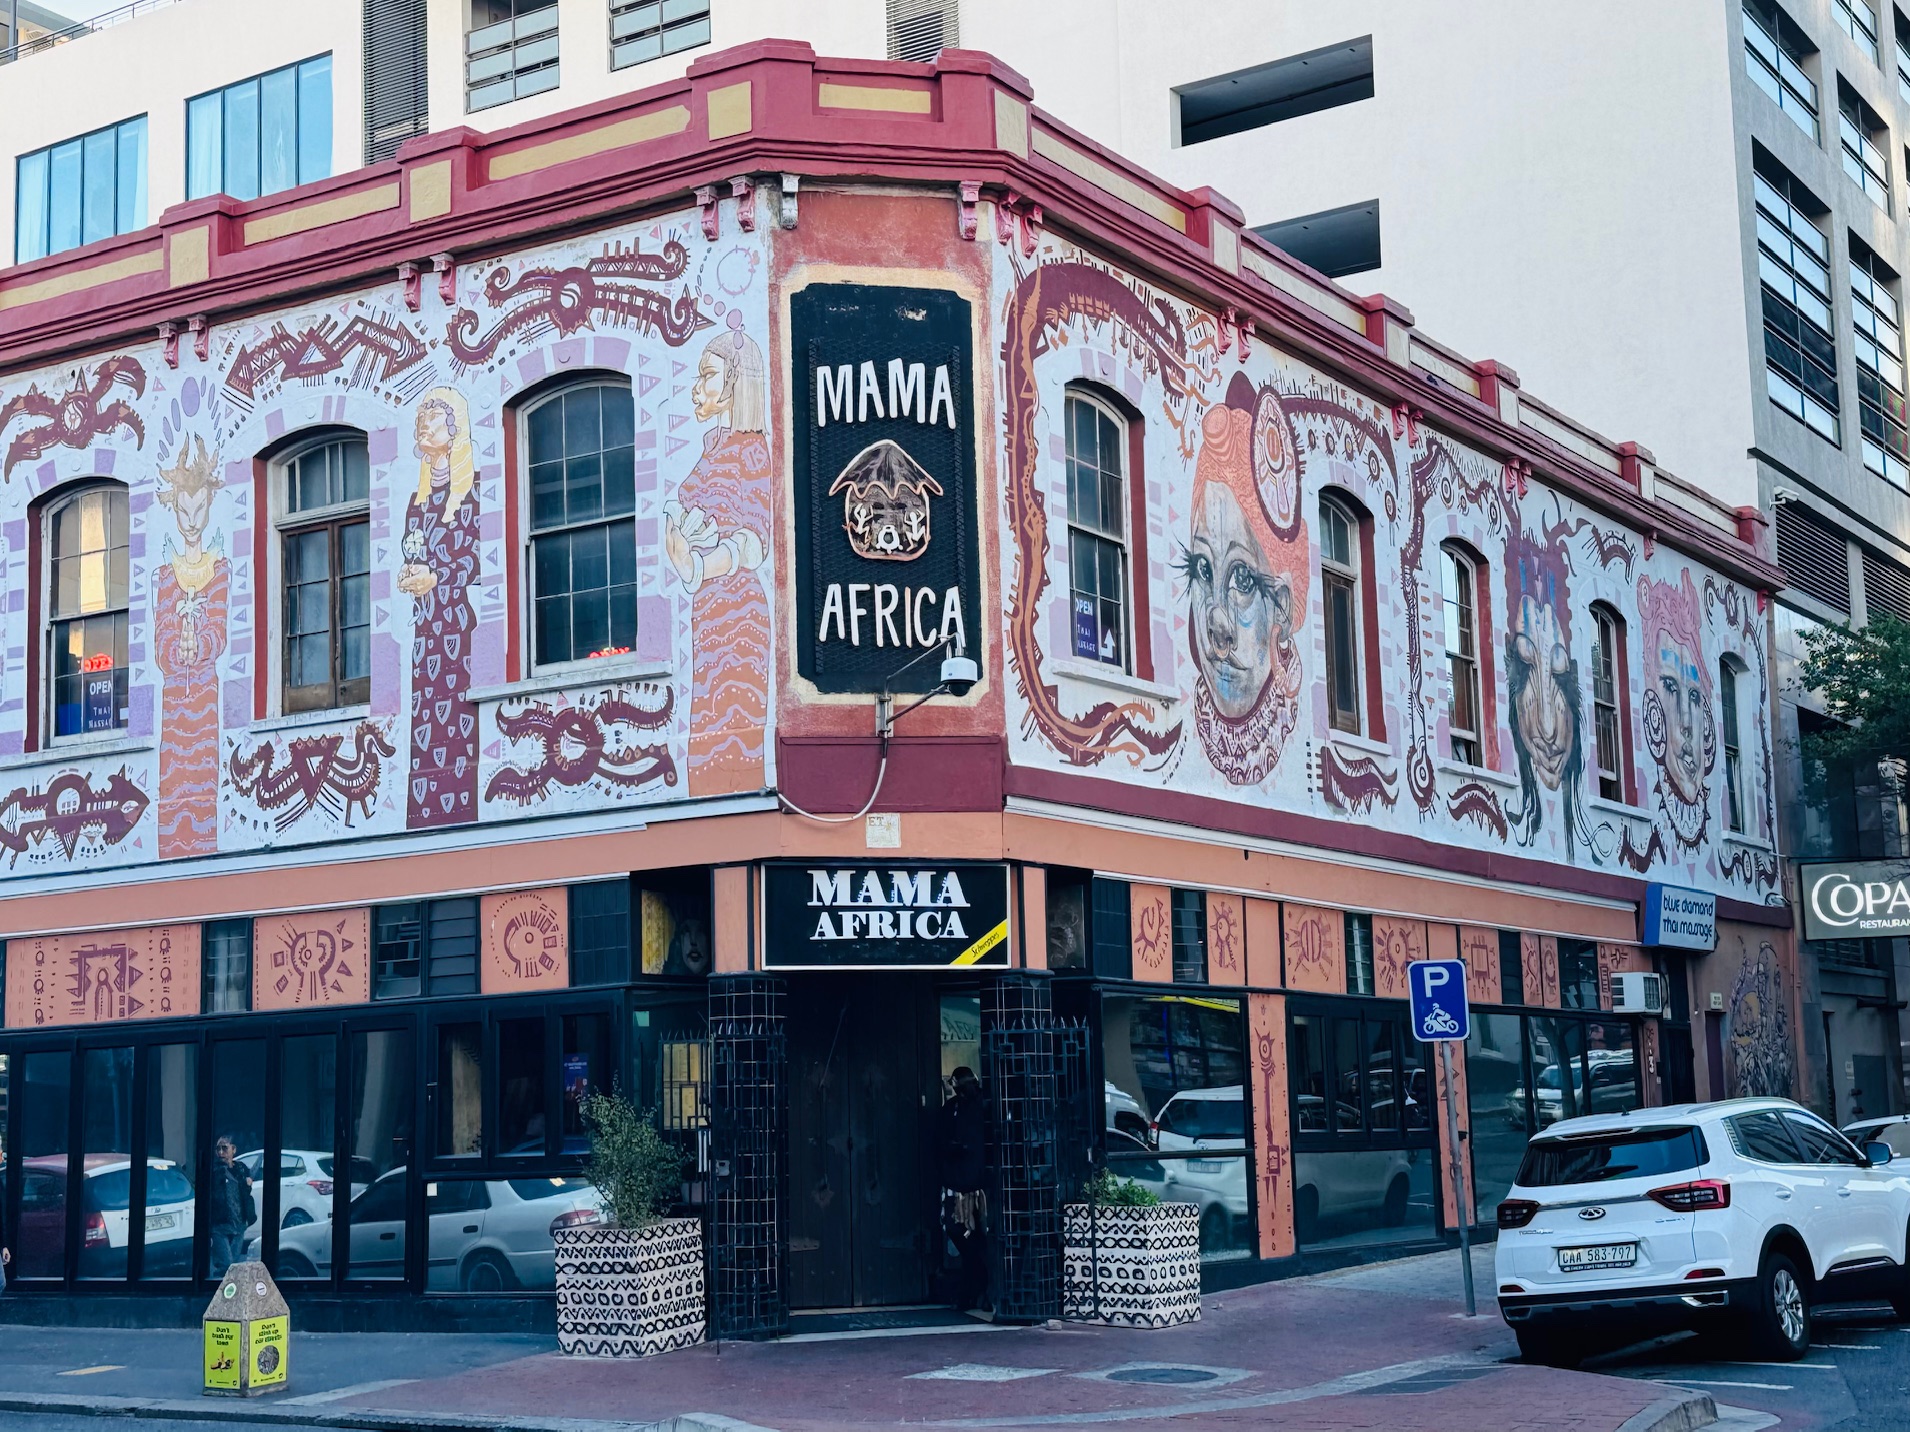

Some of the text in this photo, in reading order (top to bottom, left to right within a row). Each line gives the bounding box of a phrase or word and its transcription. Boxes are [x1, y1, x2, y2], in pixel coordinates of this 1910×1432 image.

[816, 358, 956, 429] MAMA
[818, 583, 965, 648] AFRICA
[807, 869, 970, 907] MAMA
[1811, 873, 1910, 926] COPA
[1664, 895, 1713, 917] blue diamond
[810, 911, 969, 940] AFRICA
[1680, 921, 1712, 943] massage
[1423, 966, 1449, 997] P
[1562, 1246, 1631, 1264] CAA 583-797
